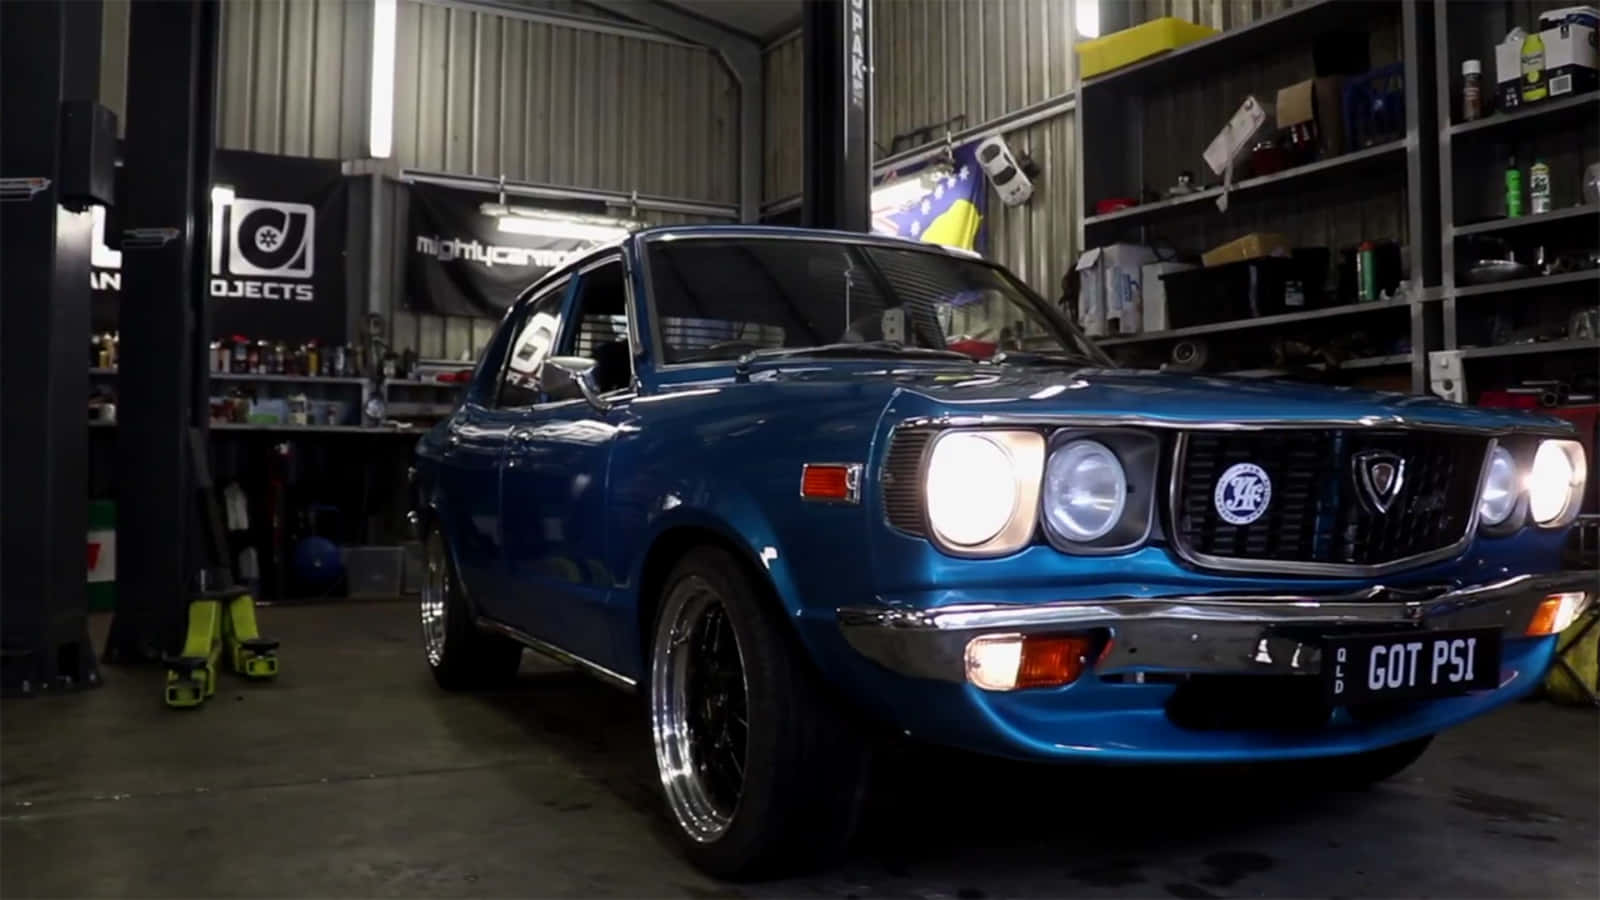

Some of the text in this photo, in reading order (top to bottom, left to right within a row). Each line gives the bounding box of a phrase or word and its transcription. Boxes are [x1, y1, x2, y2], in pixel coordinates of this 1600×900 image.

[1334, 647, 1346, 694] QLD
[1368, 638, 1476, 690] GOT PSI
